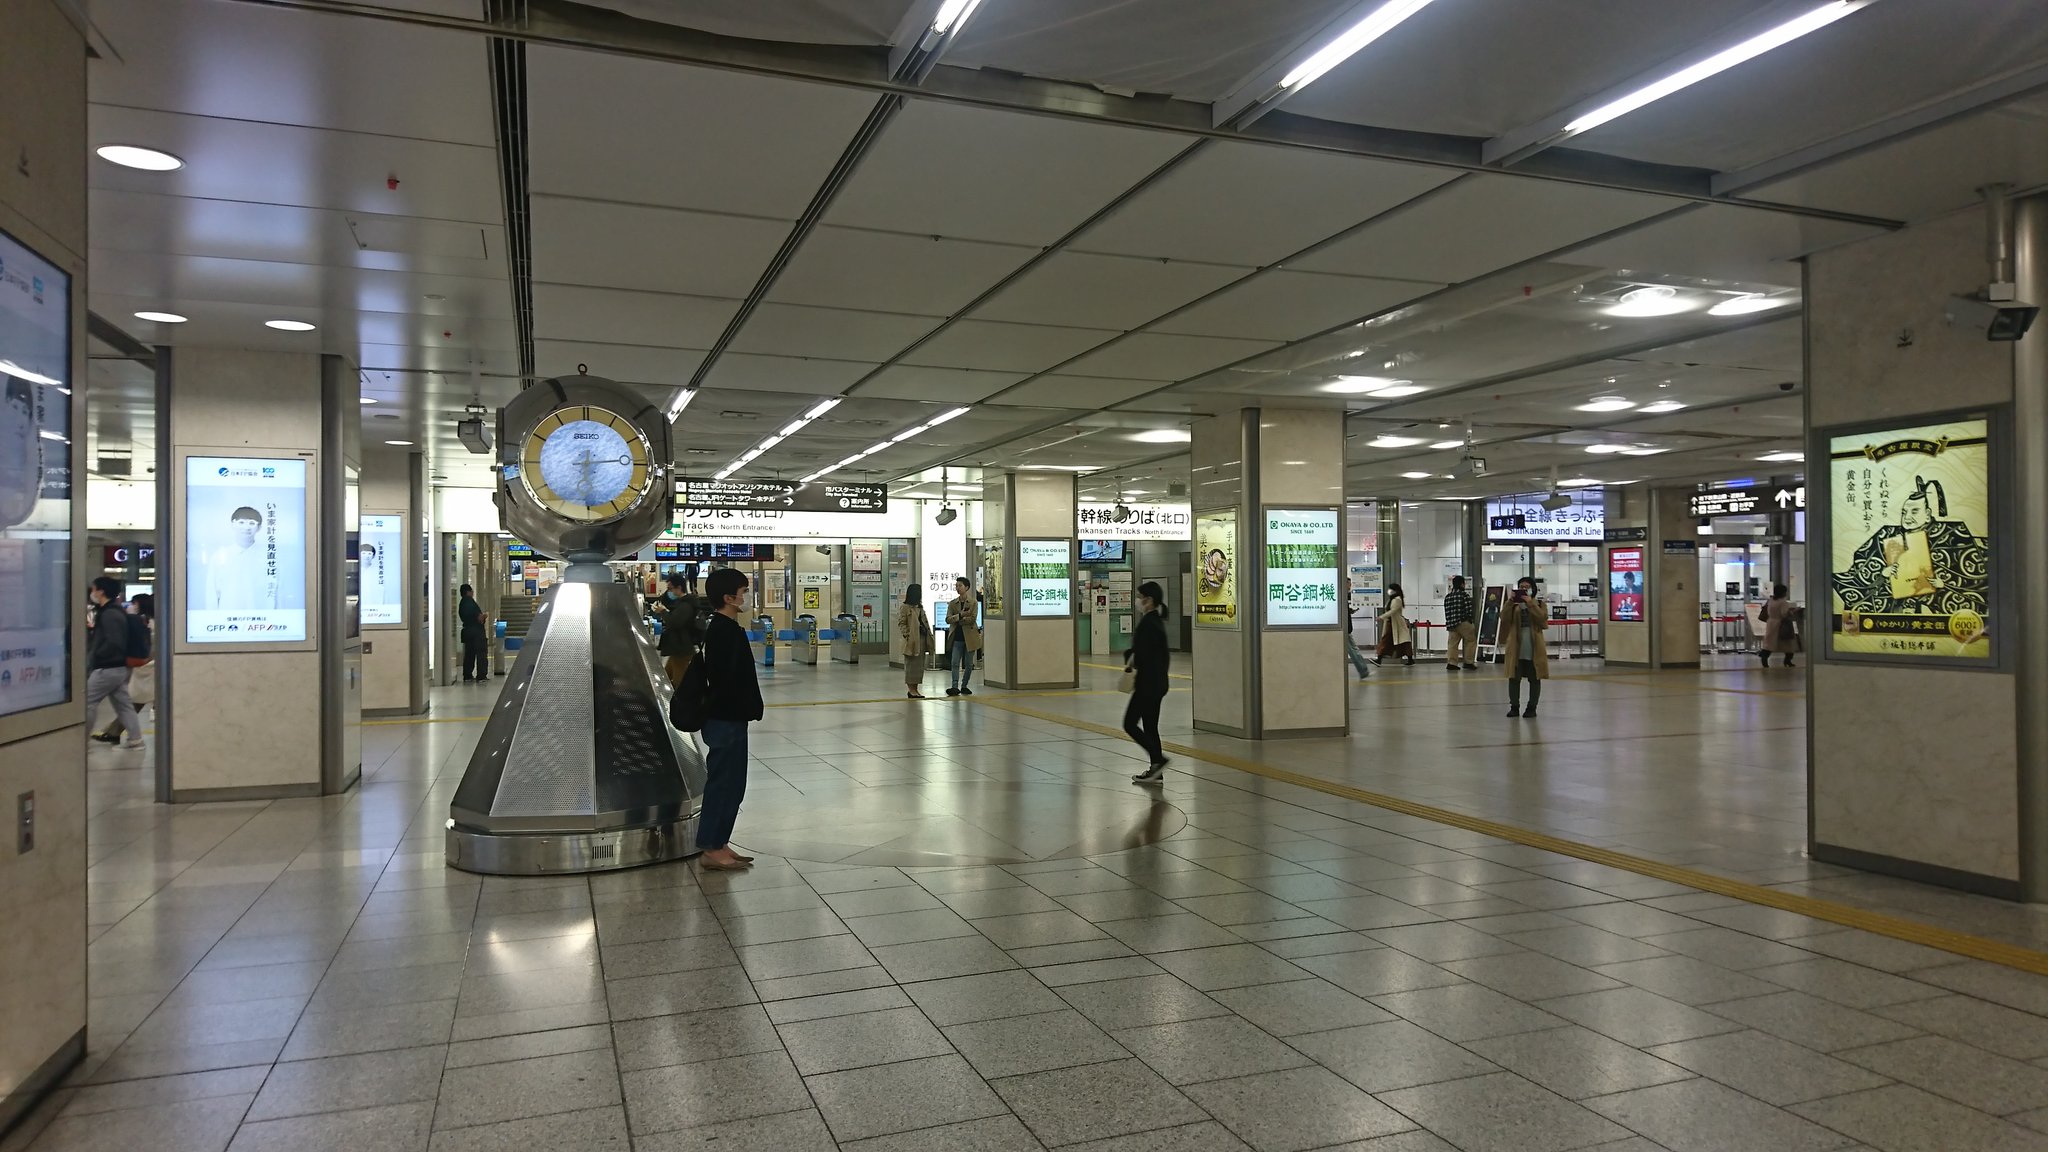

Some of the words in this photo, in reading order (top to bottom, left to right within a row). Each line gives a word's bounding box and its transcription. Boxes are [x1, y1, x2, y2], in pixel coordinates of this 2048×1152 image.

[825, 486, 872, 494] 市バスターミナル
[1077, 508, 1190, 525] 幹線りば(北口)
[1116, 527, 1141, 535] Tracks
[1556, 526, 1570, 535] and
[1572, 527, 1583, 536] JR
[1585, 527, 1602, 536] Line
[930, 572, 960, 582] 新幹線
[1022, 588, 1069, 601] 岡谷鋼機
[1269, 583, 1337, 602] 岡谷鋼機
[206, 624, 226, 632] CFP
[247, 624, 266, 632] AFP
